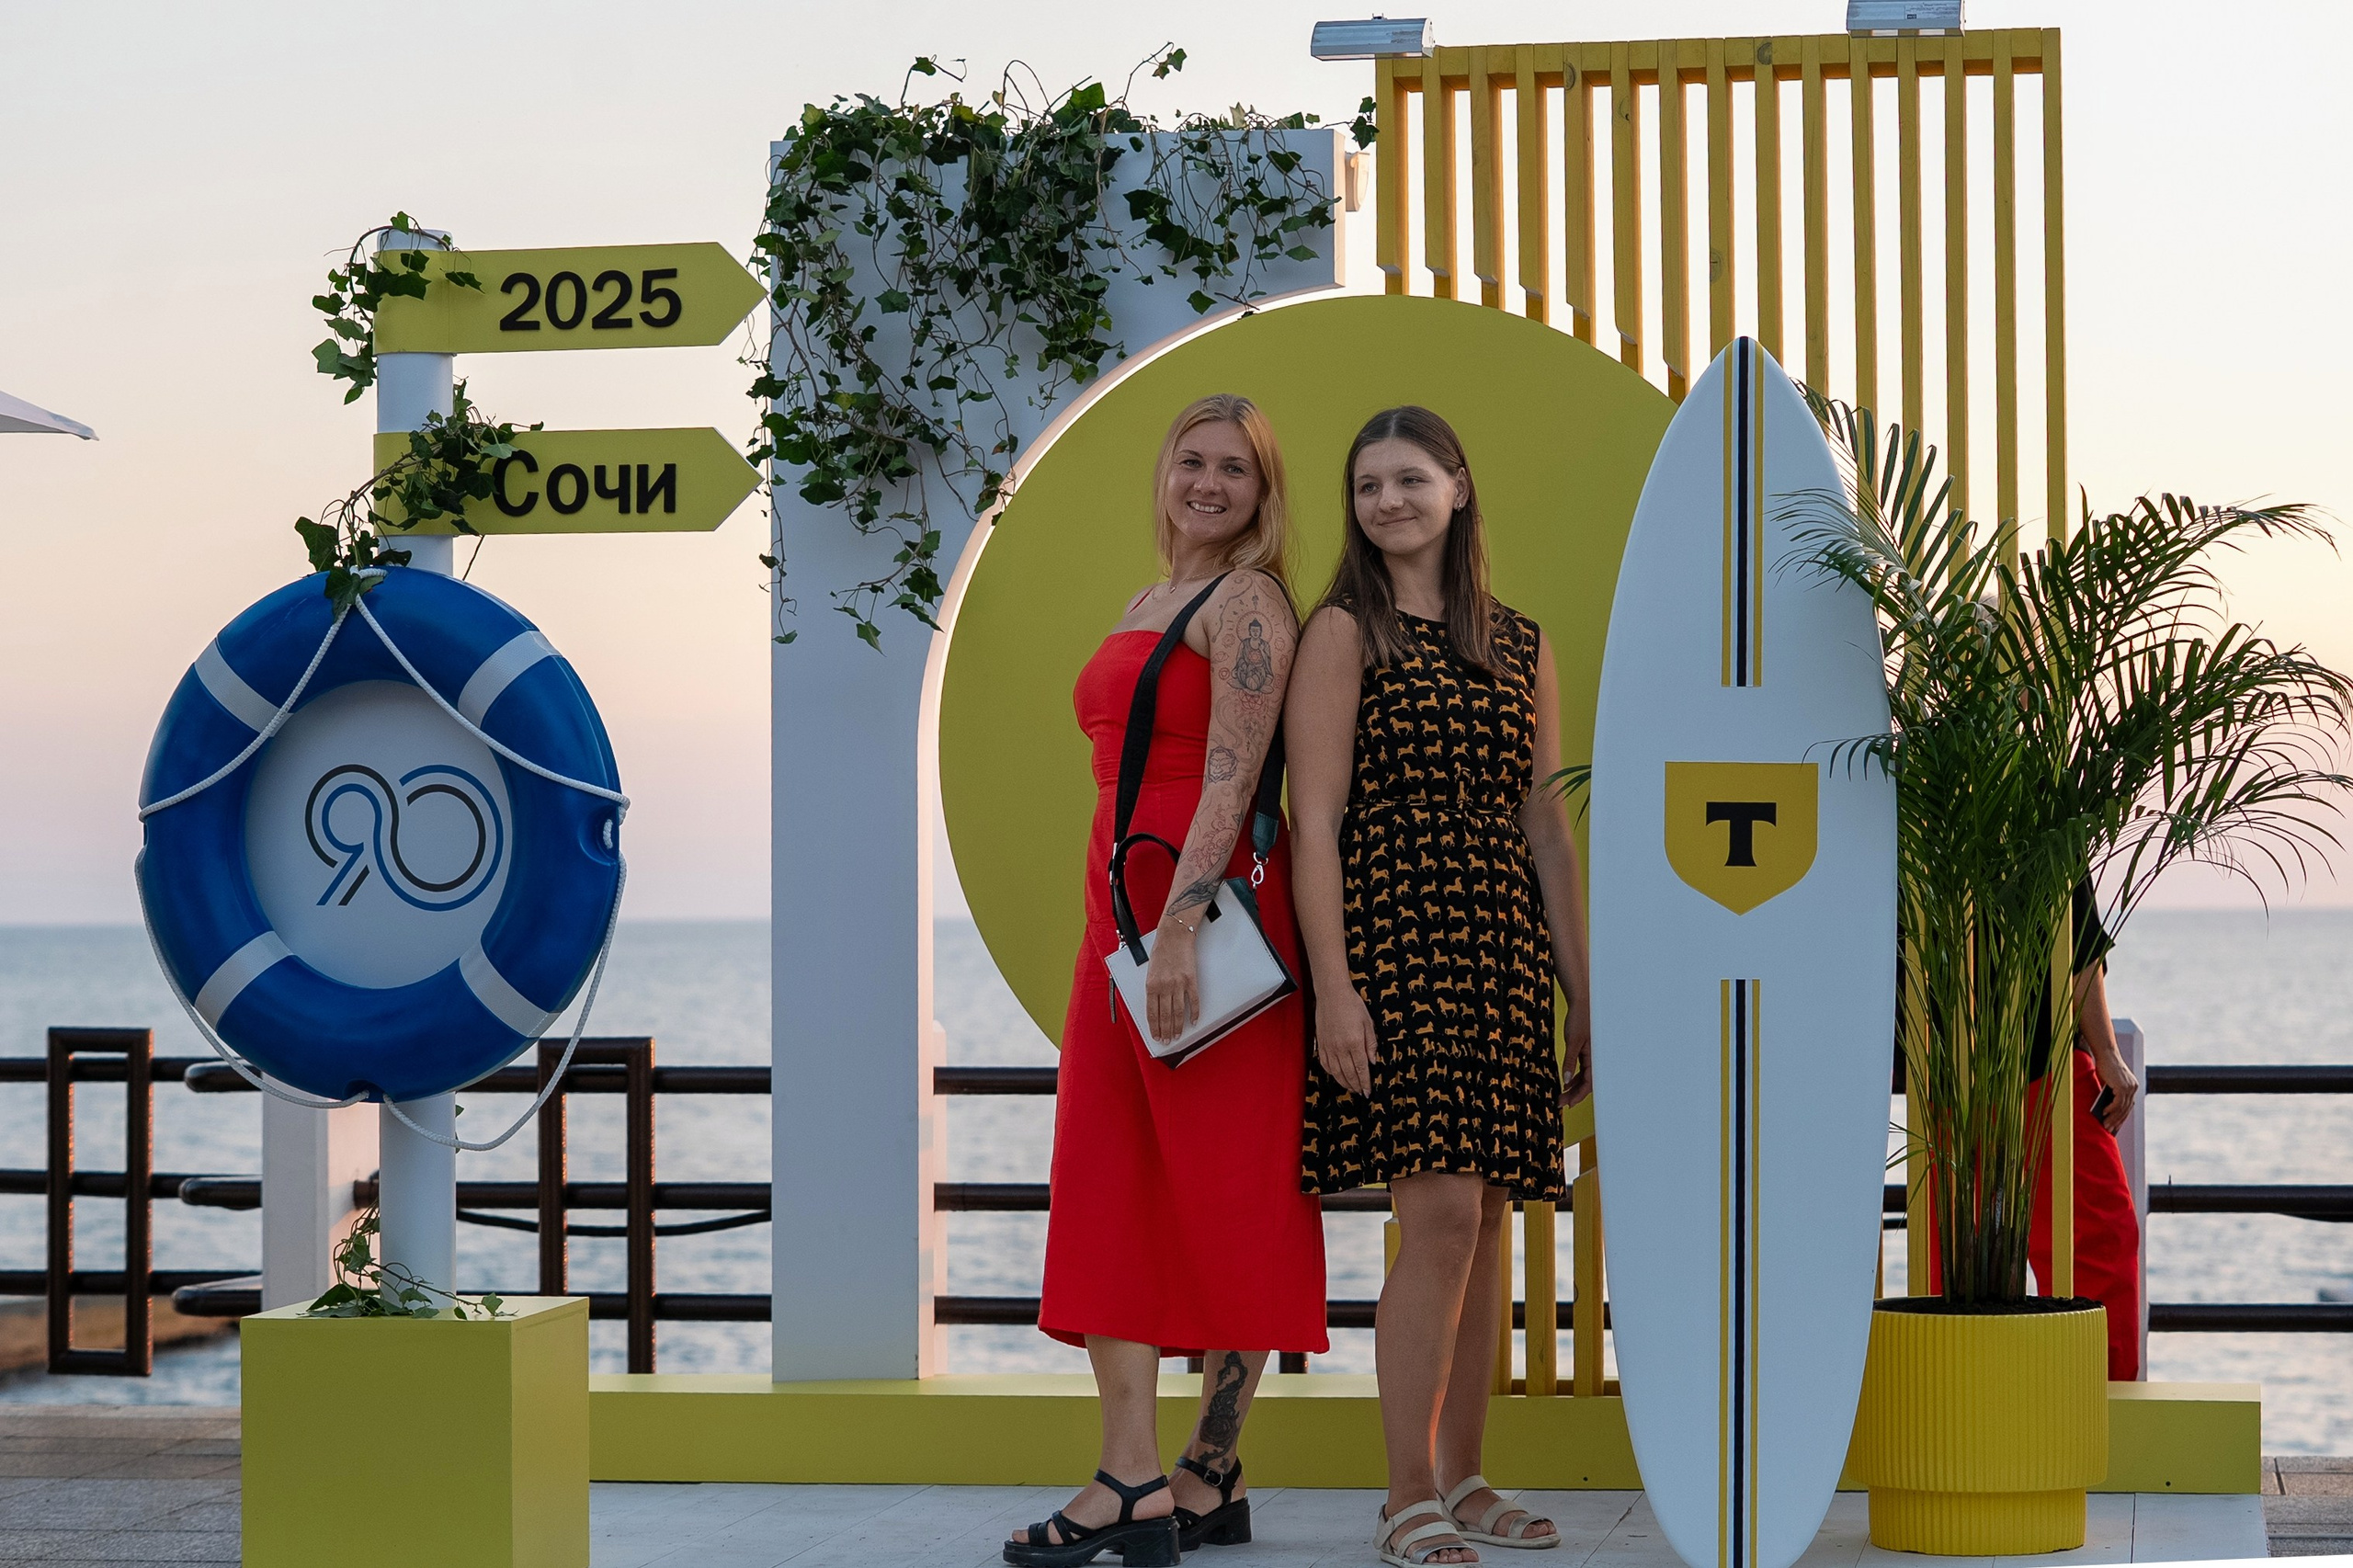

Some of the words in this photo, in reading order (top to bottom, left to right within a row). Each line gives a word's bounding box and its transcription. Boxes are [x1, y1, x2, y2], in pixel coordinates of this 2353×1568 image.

[500, 268, 682, 332] 2025
[493, 449, 676, 517] Сочи
[305, 764, 504, 912] 90
